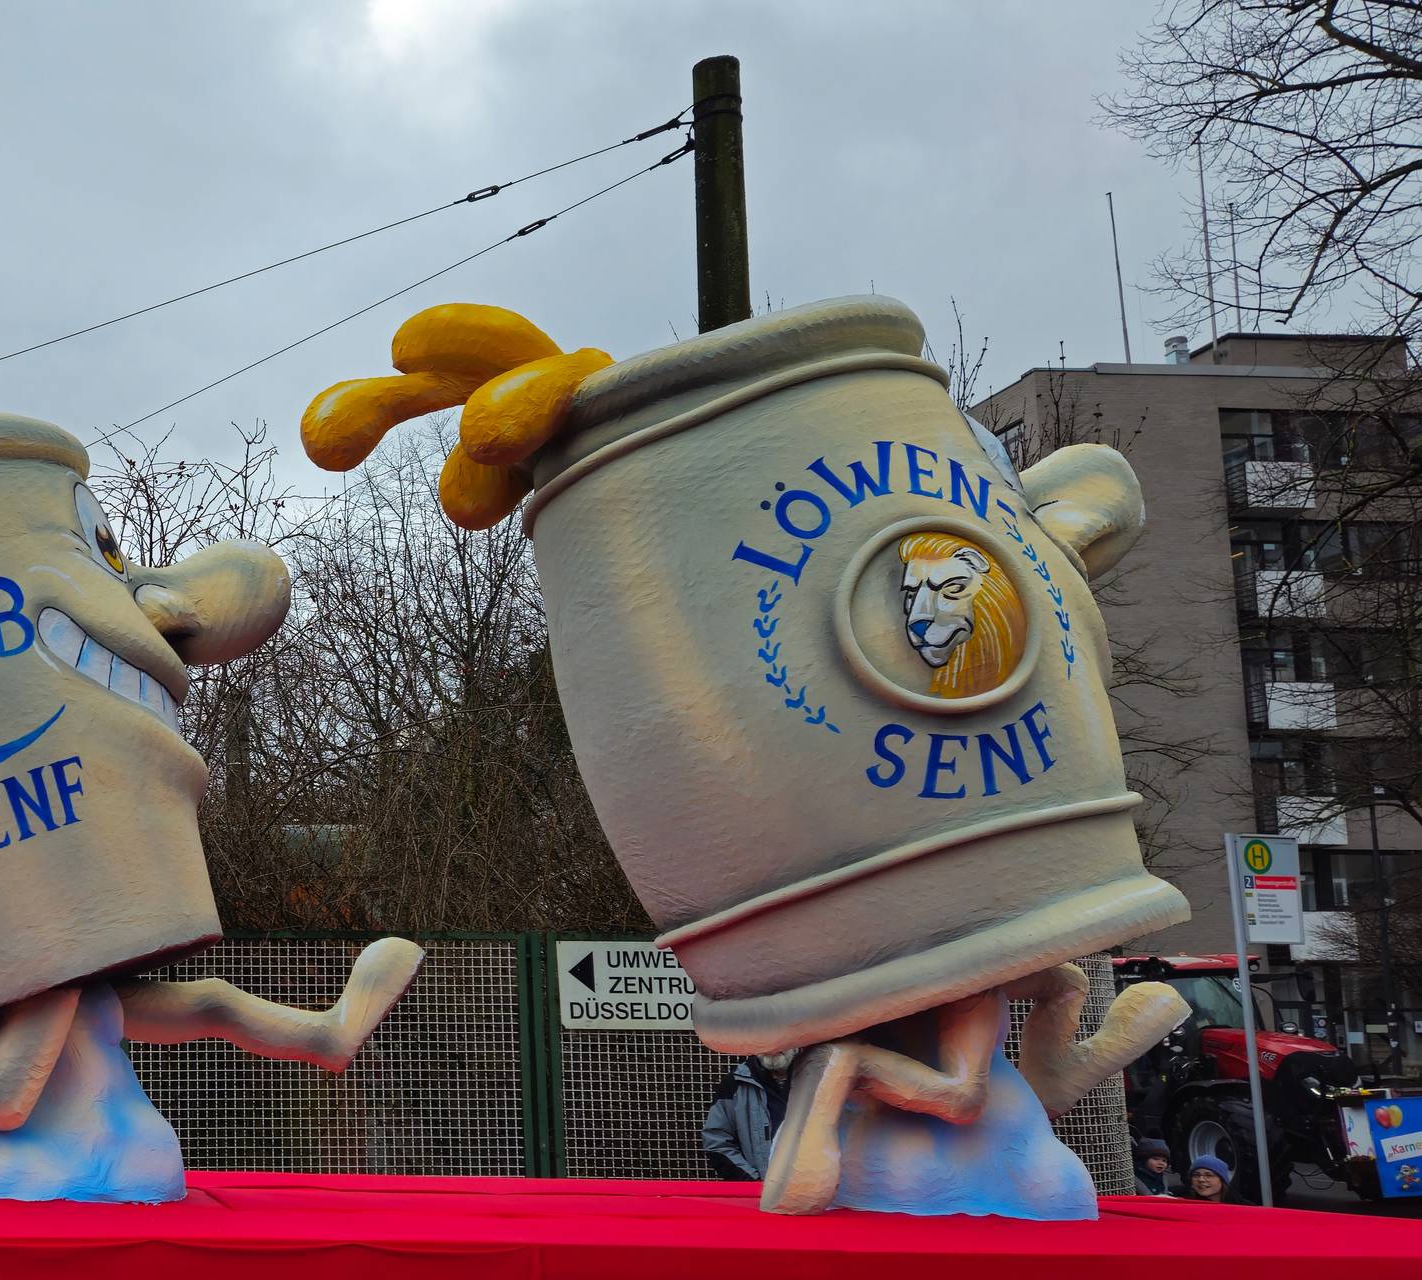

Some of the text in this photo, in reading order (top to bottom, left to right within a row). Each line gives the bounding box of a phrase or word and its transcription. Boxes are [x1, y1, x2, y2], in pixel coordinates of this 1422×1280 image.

[865, 701, 1058, 799] SENF
[608, 976, 697, 995] ZENTRU
[569, 997, 693, 1020] DÜSSELDO
